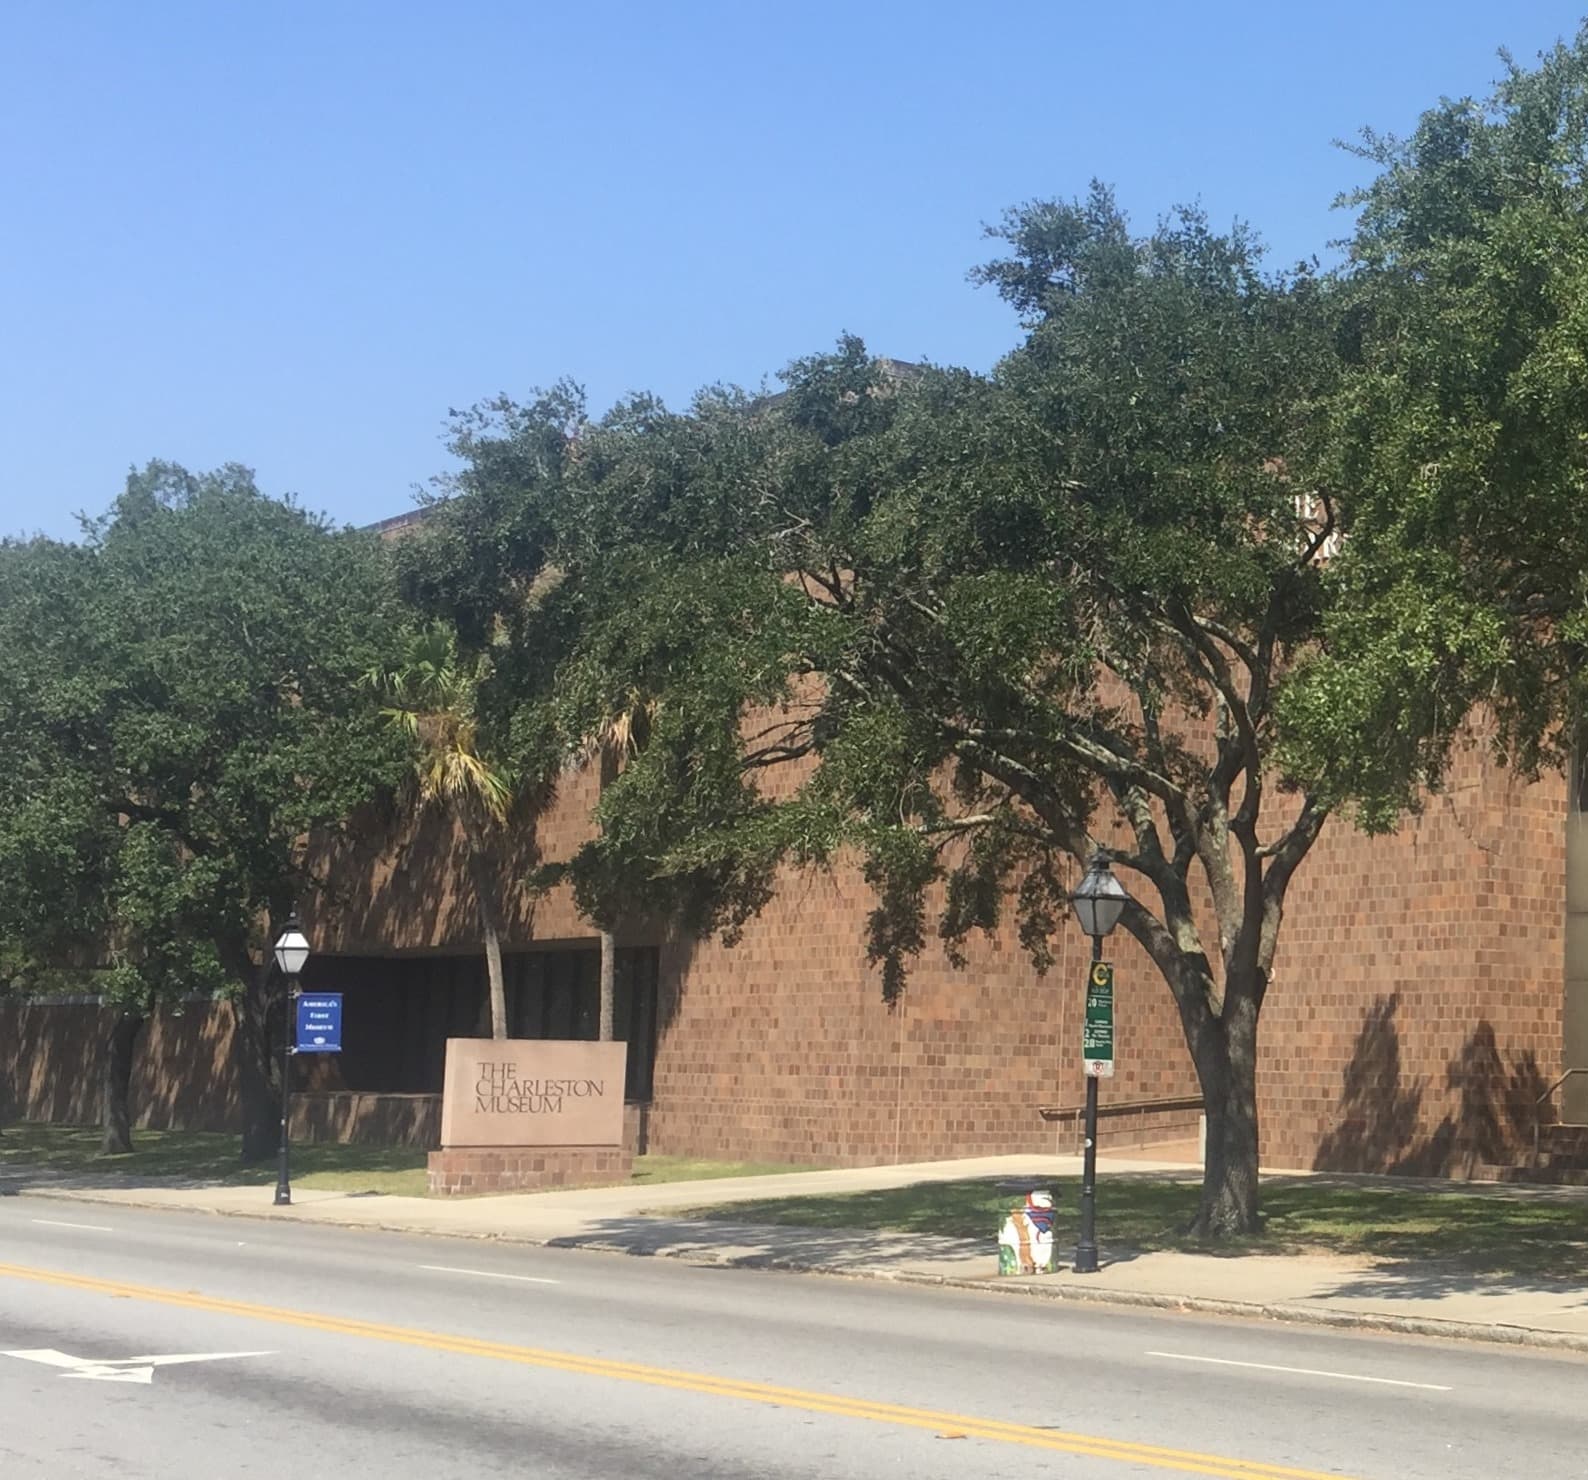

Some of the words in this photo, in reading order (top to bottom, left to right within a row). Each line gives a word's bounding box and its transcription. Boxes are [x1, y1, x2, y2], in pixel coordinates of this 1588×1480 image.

[477, 1062, 517, 1080] THE
[475, 1079, 604, 1097] CHARLESTON
[475, 1096, 563, 1114] MUSEUM
